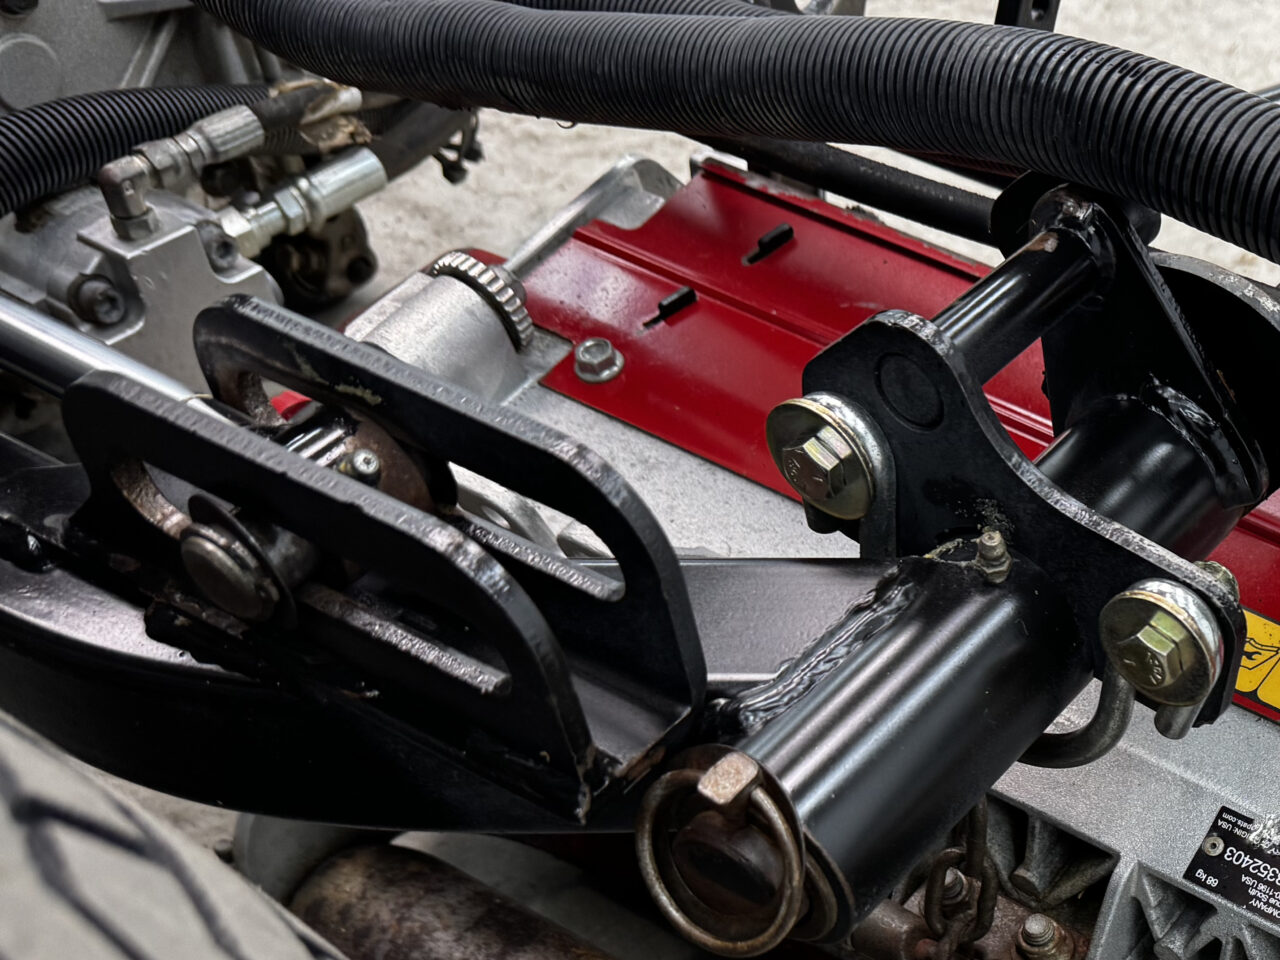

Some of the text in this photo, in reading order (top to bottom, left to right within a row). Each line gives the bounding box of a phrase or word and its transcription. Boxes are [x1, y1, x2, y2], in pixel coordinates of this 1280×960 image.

[1217, 818, 1232, 830] USA
[1195, 868, 1218, 887] 68 kg
[1241, 873, 1257, 887] USA
[1248, 886, 1268, 902] South
